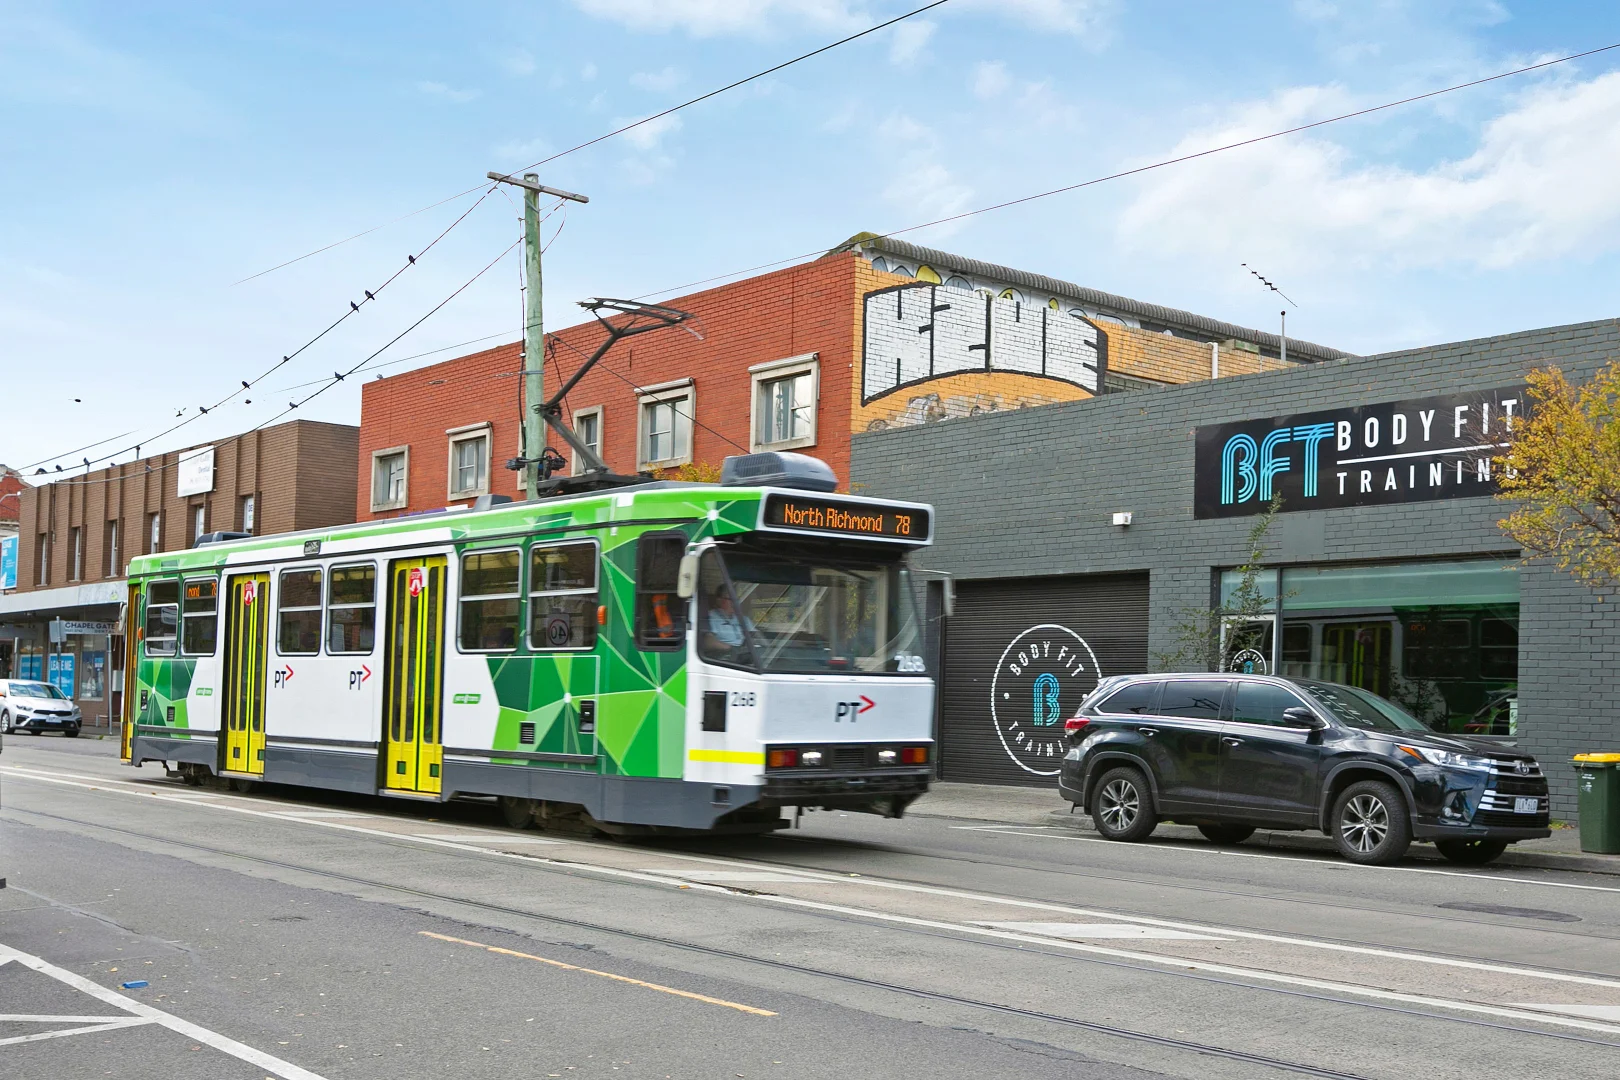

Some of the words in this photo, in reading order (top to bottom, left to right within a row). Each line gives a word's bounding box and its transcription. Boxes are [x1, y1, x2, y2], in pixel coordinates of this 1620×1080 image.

[1337, 409, 1435, 451] BODY
[1454, 399, 1518, 438] FIT
[1221, 422, 1335, 505] BFT
[1336, 455, 1518, 495] TRAINING
[784, 504, 824, 527] North
[826, 507, 883, 532] Richmond
[895, 515, 911, 535] 78
[50, 660, 65, 671] LEAE
[1009, 641, 1051, 676] BODY
[1057, 645, 1085, 677] FIT
[274, 670, 287, 689] PT
[349, 670, 363, 690] PT
[731, 691, 757, 706] 268
[834, 701, 862, 723] PT
[1008, 720, 1068, 757] TRAINI
